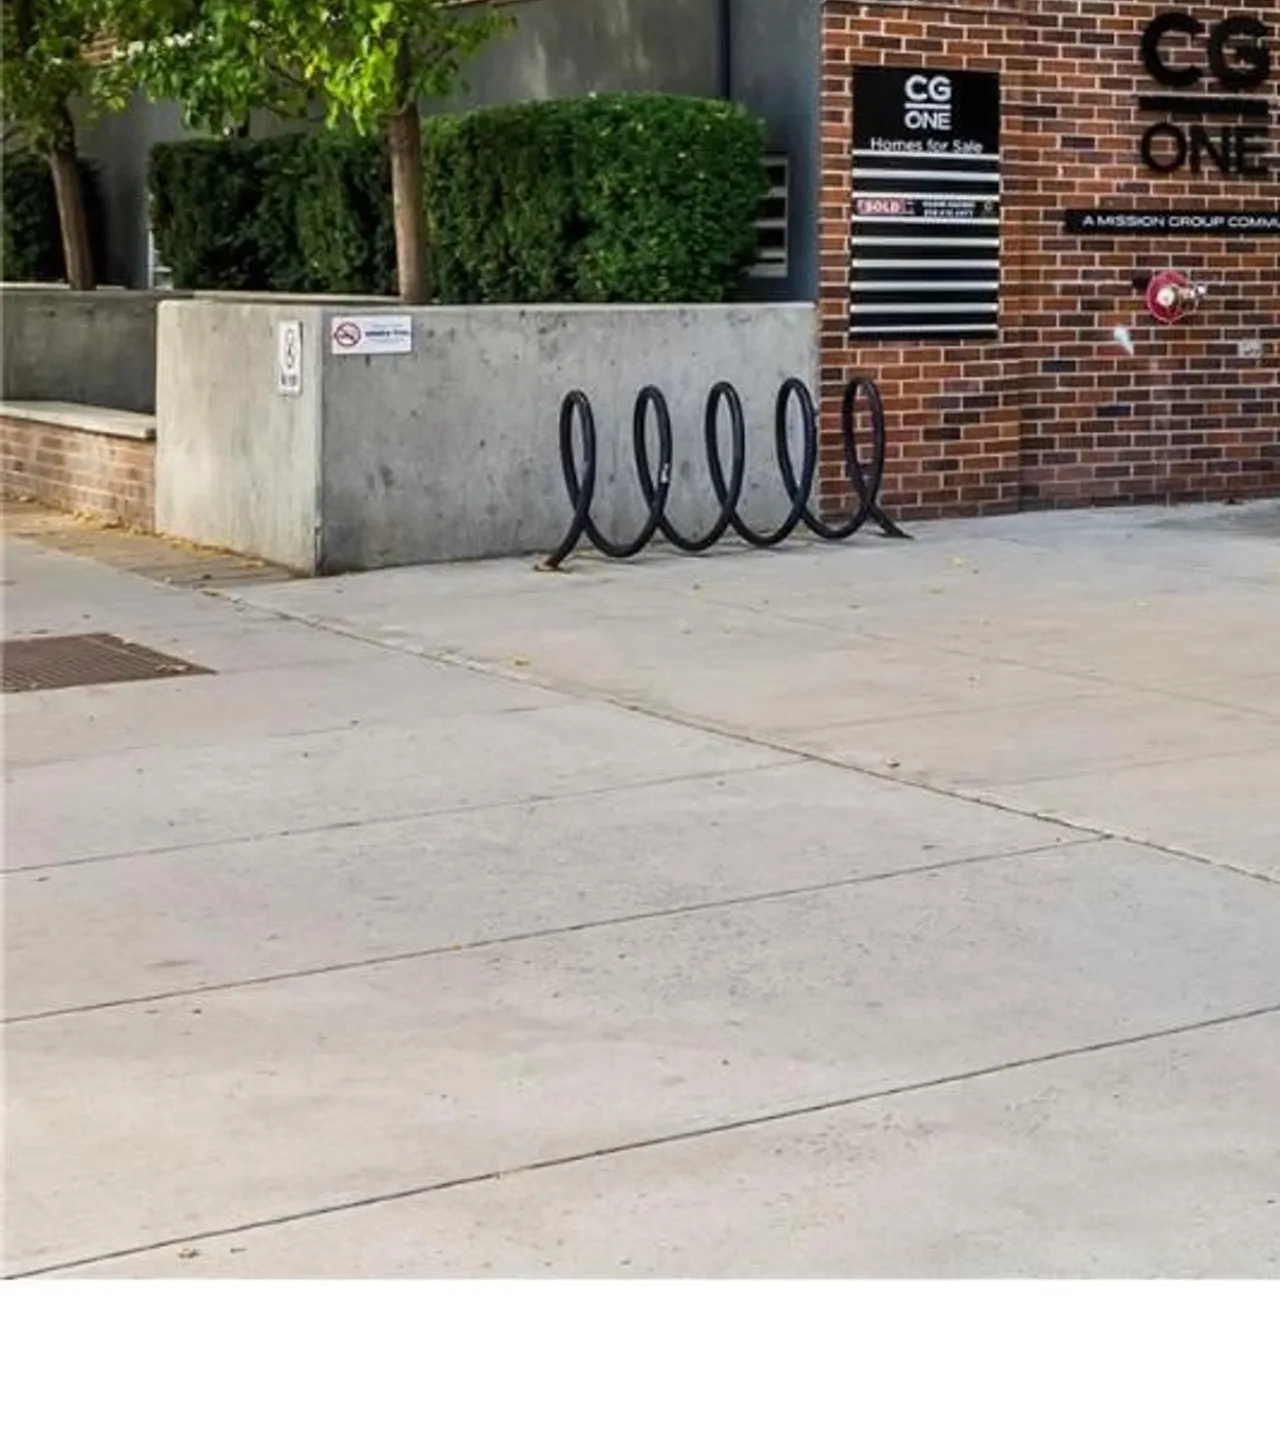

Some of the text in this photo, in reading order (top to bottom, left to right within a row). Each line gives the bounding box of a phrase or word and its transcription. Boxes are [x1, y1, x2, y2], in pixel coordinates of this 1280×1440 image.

[1140, 13, 1270, 91] CG
[904, 74, 952, 102] CG
[904, 110, 952, 131] ONE
[870, 136, 983, 155] Homes for Sale
[1140, 122, 1269, 174] ONE
[865, 199, 901, 213] SOLD
[1082, 216, 1094, 227] A
[1097, 216, 1165, 228] MISSION
[1168, 216, 1225, 228] GROUP
